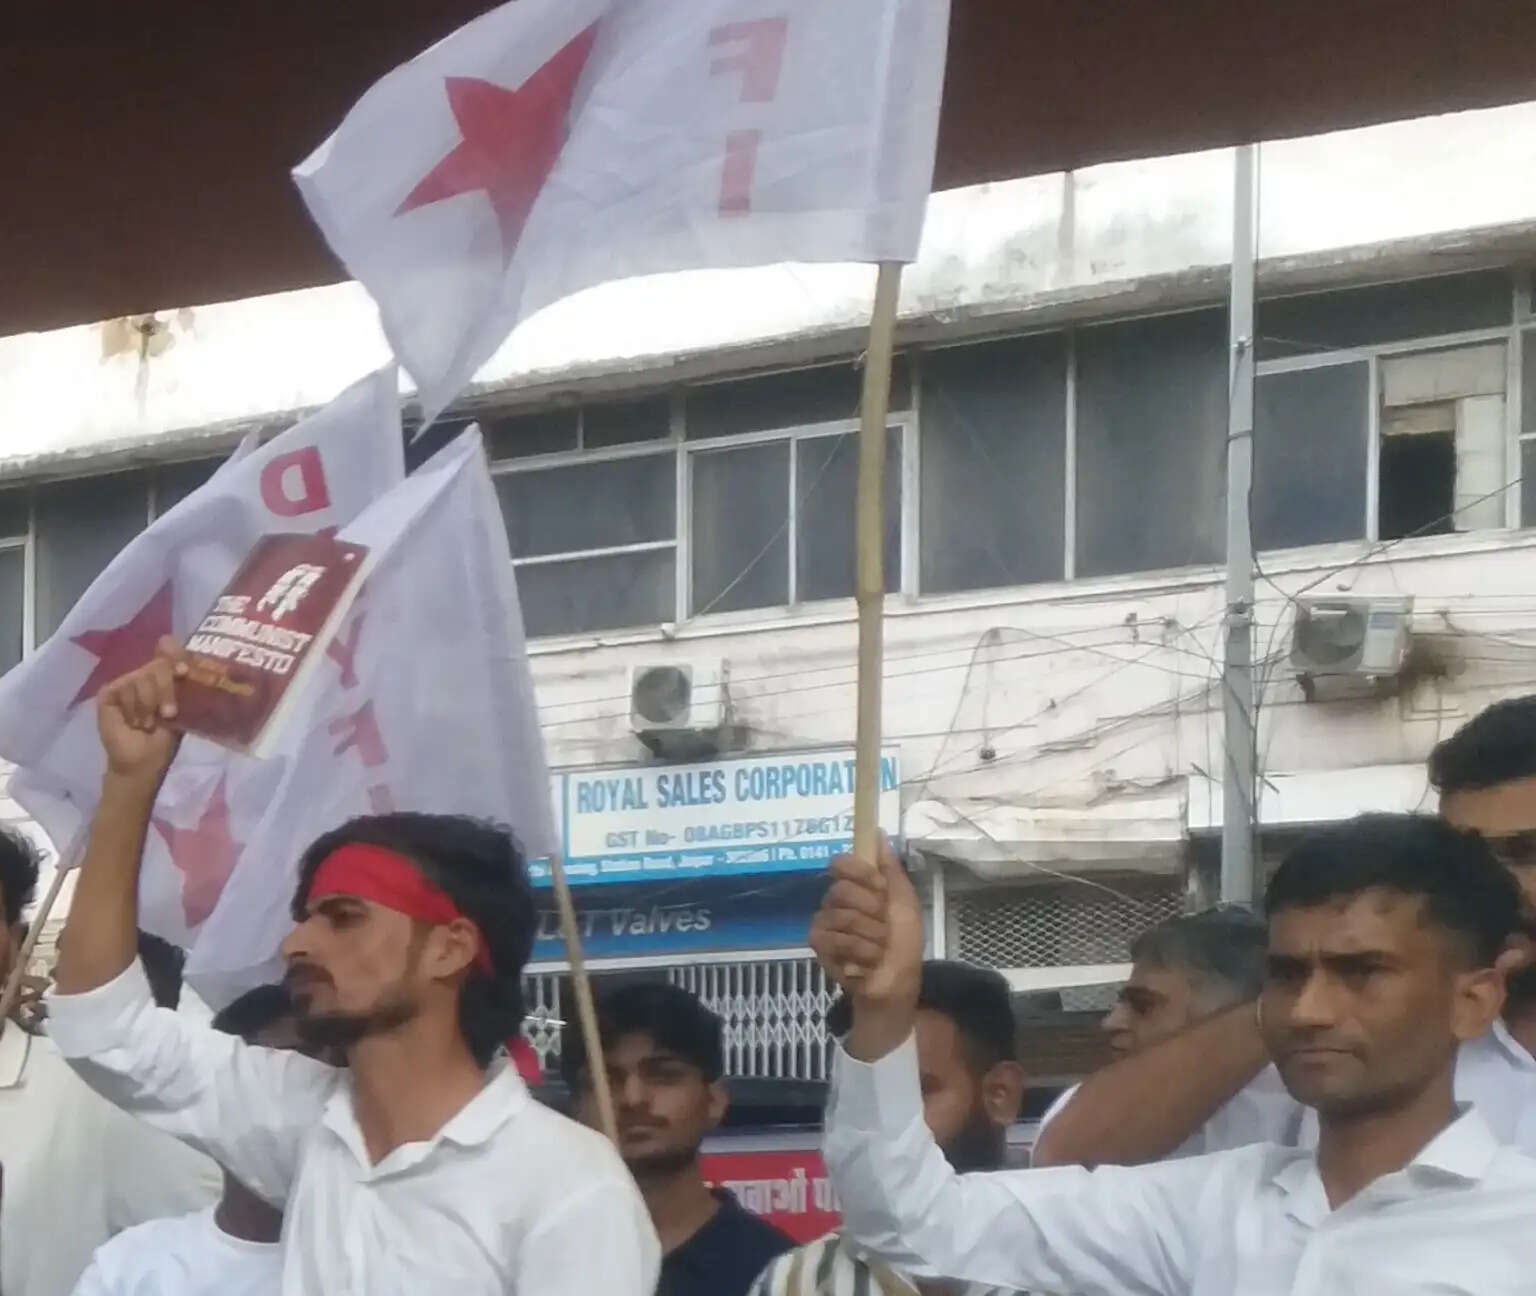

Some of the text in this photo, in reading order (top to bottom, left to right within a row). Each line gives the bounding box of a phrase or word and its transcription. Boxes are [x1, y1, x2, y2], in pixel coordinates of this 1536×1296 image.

[577, 756, 898, 814] ROYAL SALES CORPORATN
[536, 904, 713, 941] LT Valves
